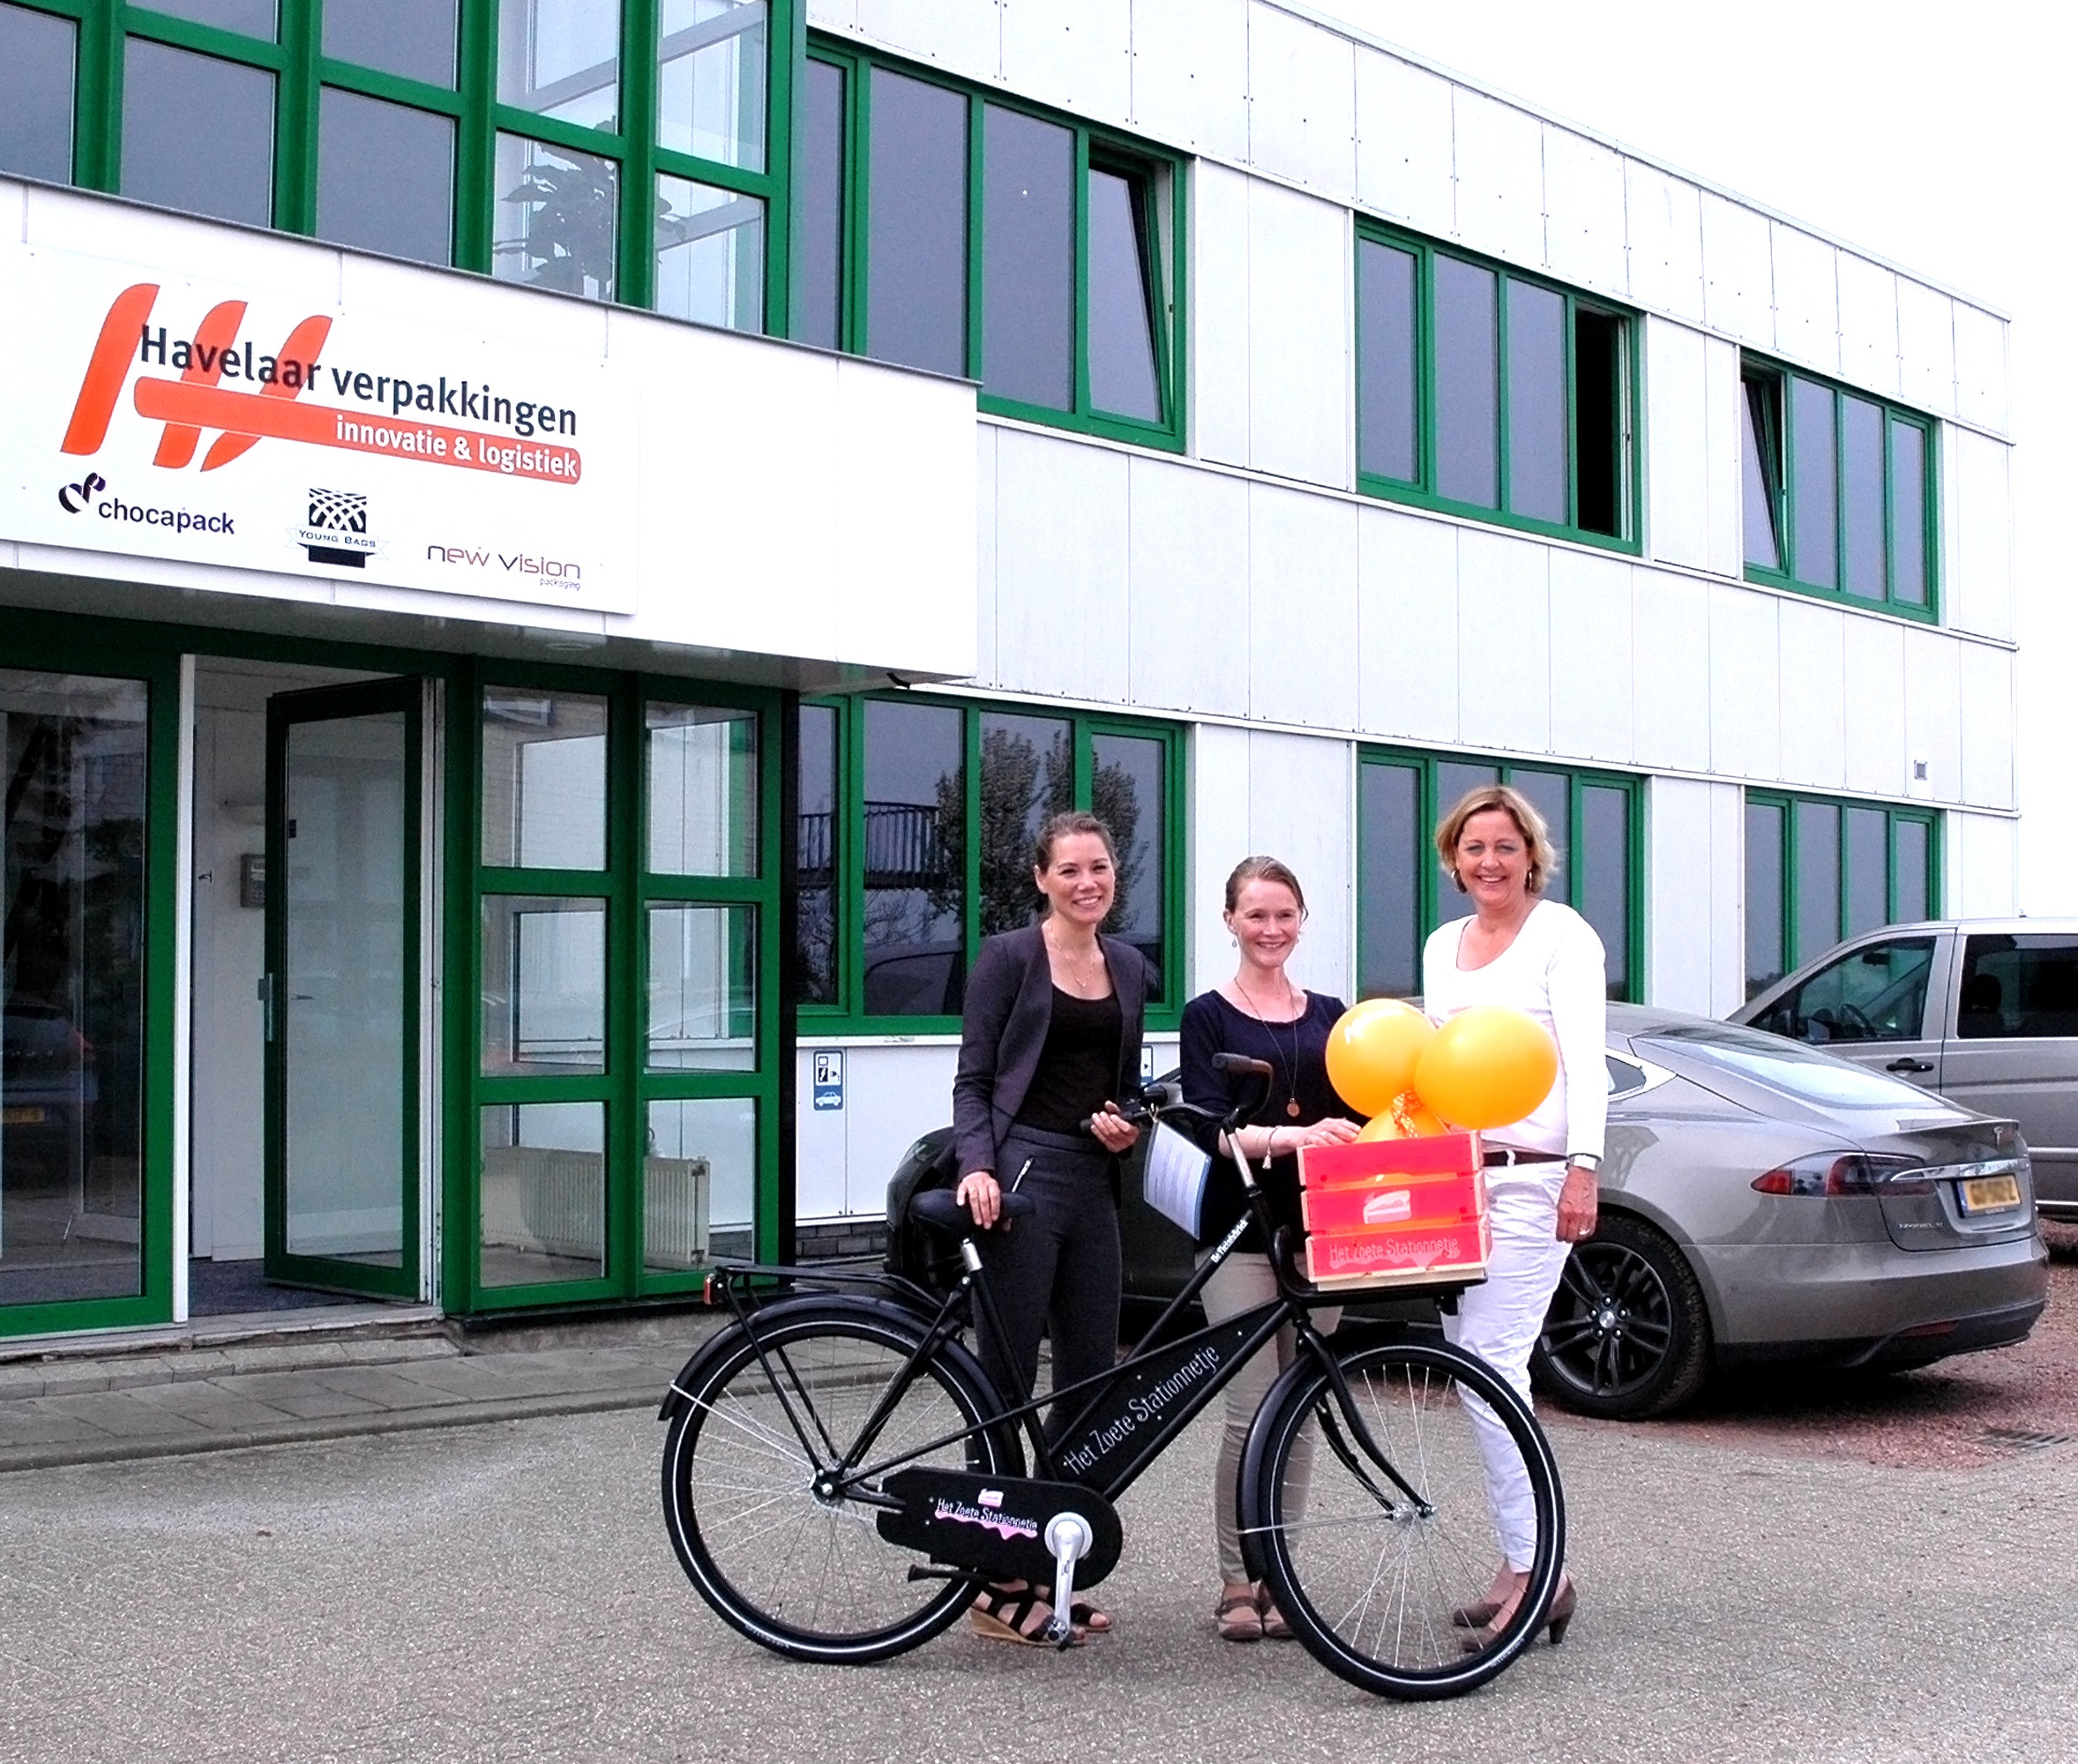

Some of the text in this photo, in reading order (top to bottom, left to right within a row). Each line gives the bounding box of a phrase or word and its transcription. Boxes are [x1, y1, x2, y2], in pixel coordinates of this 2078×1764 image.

[141, 324, 576, 437] Havelaar verpakkingen
[336, 414, 578, 477] innovatie & logistiek
[98, 497, 235, 534] chocapack
[298, 529, 376, 548] YOUNG BAGS
[427, 545, 580, 579] new vision
[1329, 1244, 1349, 1261] Het
[1064, 1346, 1220, 1476] Het Zoete Stationnetje
[937, 1498, 953, 1514] Het
